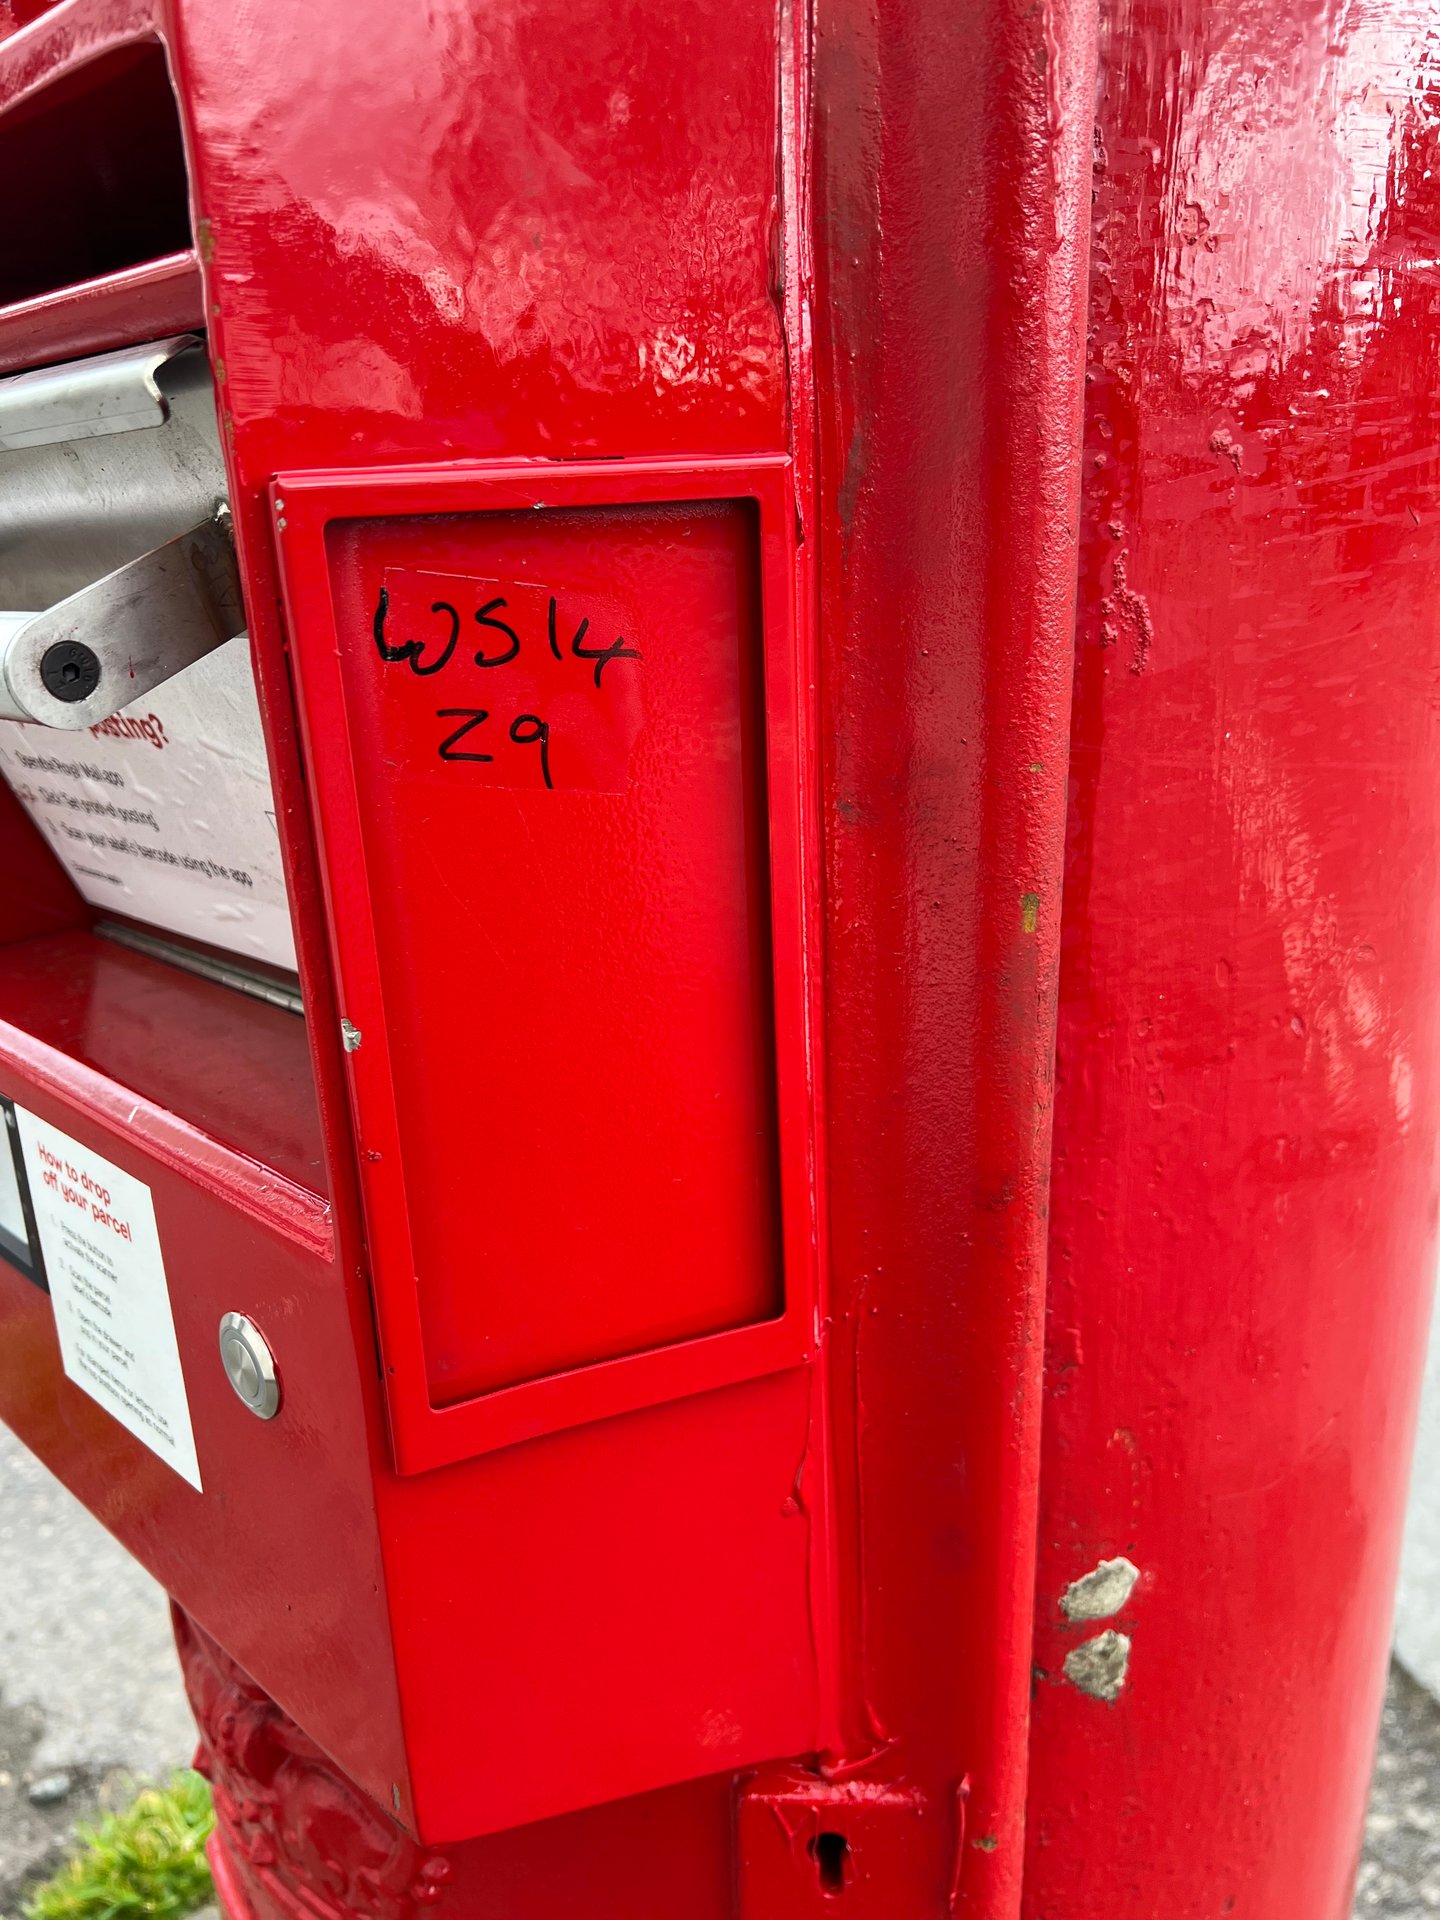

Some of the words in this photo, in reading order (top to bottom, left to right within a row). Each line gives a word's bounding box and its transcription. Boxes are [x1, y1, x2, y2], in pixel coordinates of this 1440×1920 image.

[179, 855, 212, 879] using
[208, 859, 230, 880] the
[229, 868, 253, 888] app
[38, 1141, 62, 1172] How
[65, 1161, 79, 1183] to
[81, 1172, 111, 1207] drop
[43, 1171, 58, 1191] off
[61, 1184, 87, 1210] your
[92, 1204, 132, 1241] parcel
